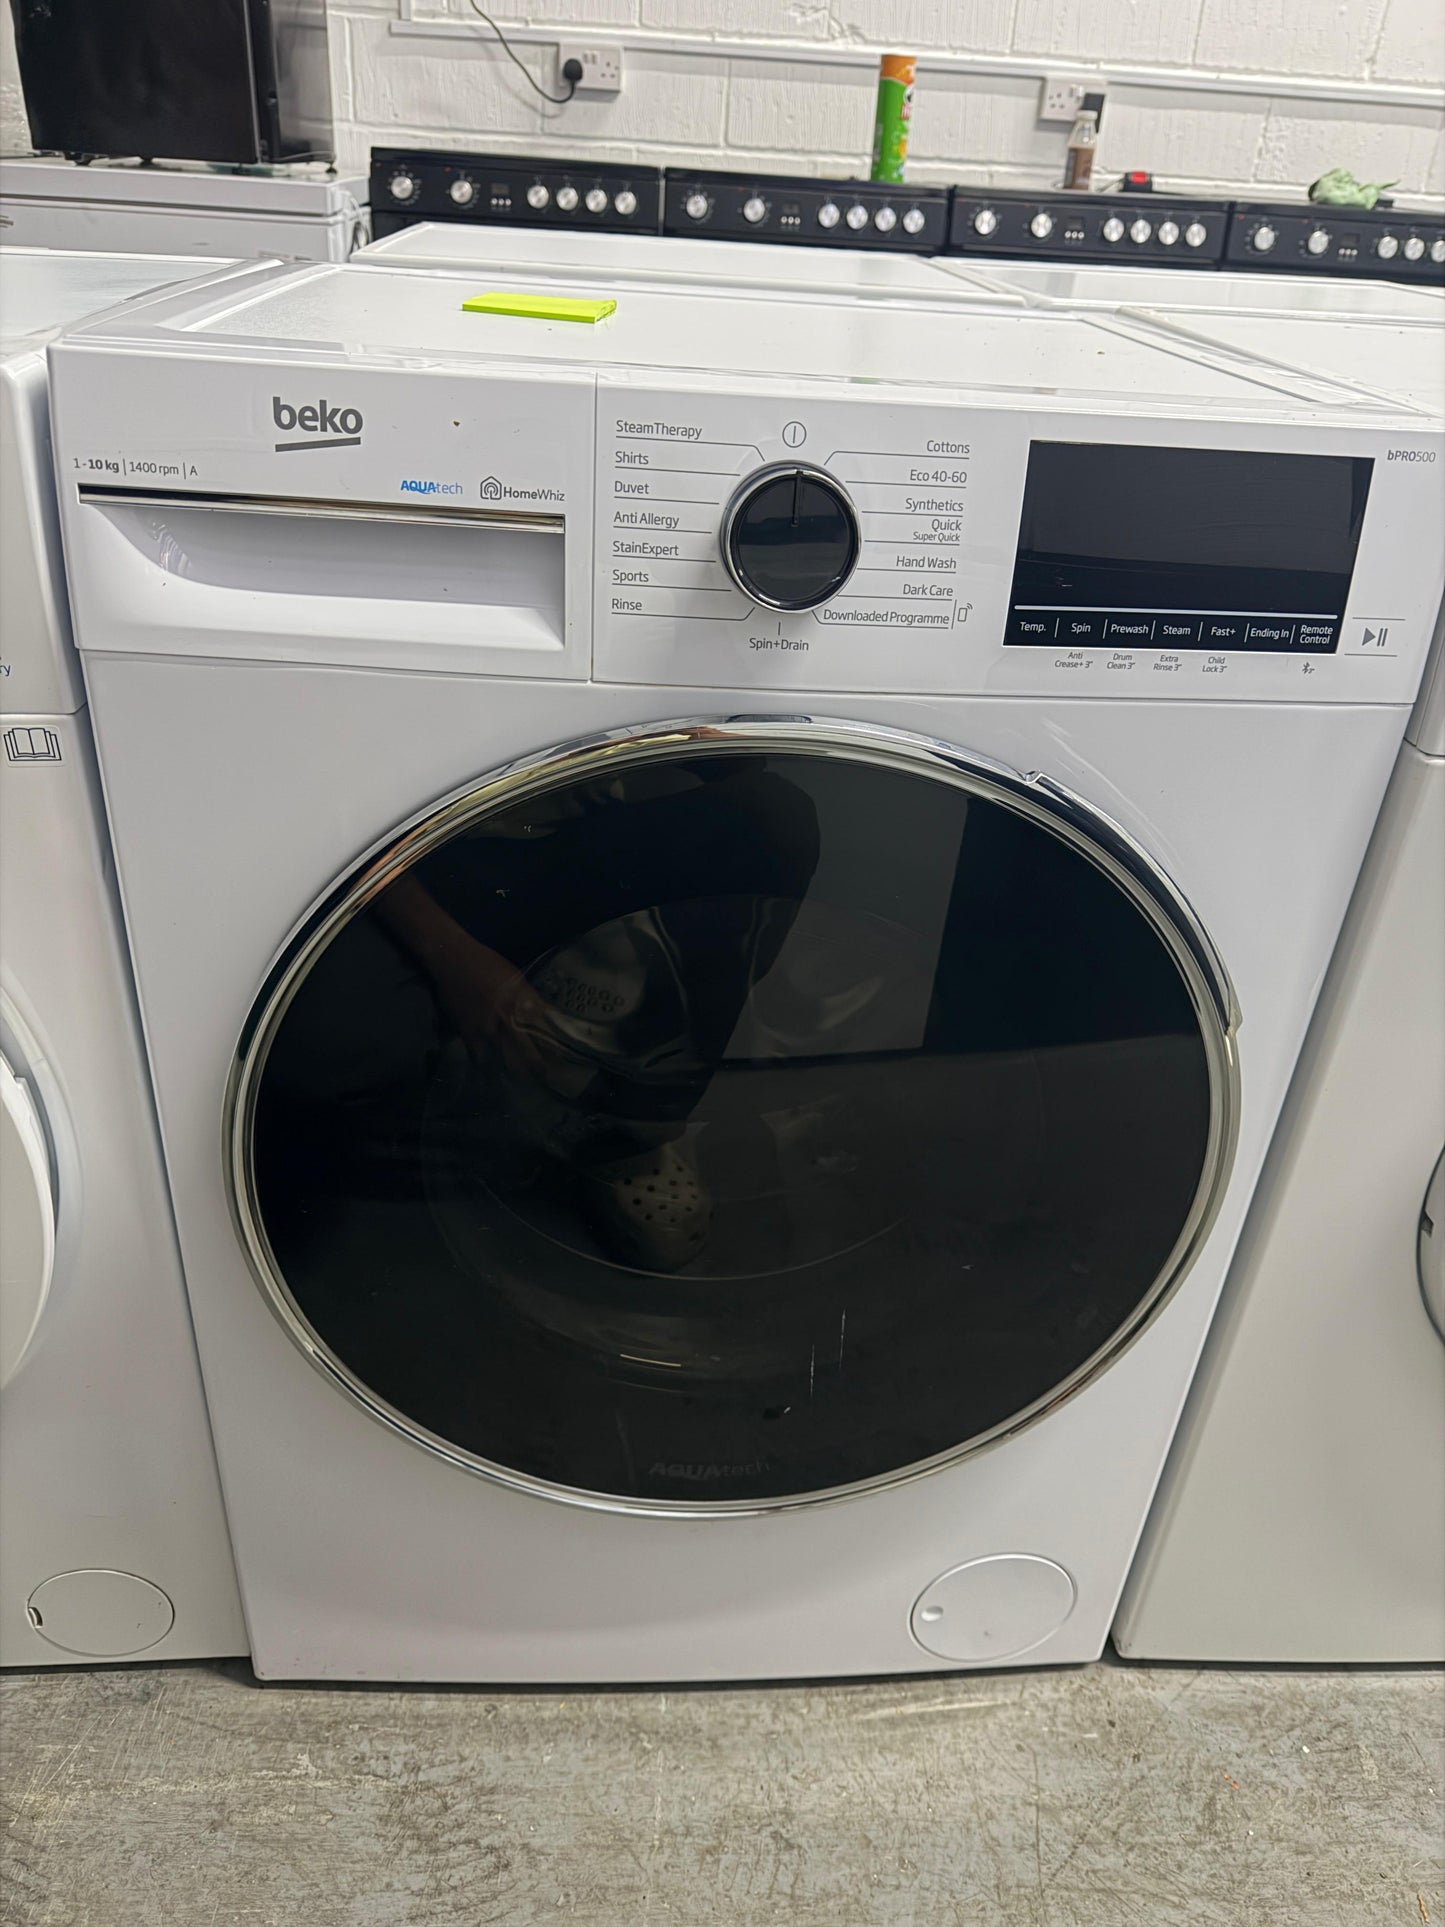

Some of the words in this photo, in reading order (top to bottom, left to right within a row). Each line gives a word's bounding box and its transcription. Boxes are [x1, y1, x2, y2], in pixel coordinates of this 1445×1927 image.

[272, 395, 364, 435] beko
[616, 420, 703, 440] SteamTherapy
[926, 440, 971, 454] Cottons
[615, 451, 650, 465] Shirts
[1386, 449, 1437, 463] bPRO500
[105, 459, 119, 474] kg
[129, 461, 157, 474] 1400
[159, 464, 180, 477] rpm
[190, 465, 199, 477] A
[910, 469, 930, 482] Eco
[931, 470, 968, 484] 40-60
[400, 479, 464, 495] AQUAtech
[614, 480, 650, 495] Duvet
[503, 486, 566, 502] HomeWhiz
[905, 498, 964, 513] Synthetics
[613, 510, 638, 525] Anti
[639, 512, 680, 529] Allergy
[931, 518, 962, 532] Quick
[913, 531, 937, 542] Super
[938, 532, 961, 543] Quick
[612, 540, 680, 558] StainExpert
[896, 555, 927, 569] Hand
[927, 557, 957, 570] Wash
[612, 569, 650, 583] Sports
[902, 584, 928, 597] Dark
[929, 585, 954, 597] Care
[611, 598, 643, 611] Rinse
[823, 609, 889, 624] Downloaded
[890, 611, 950, 626] Programme
[1019, 621, 1047, 633] Temp.
[1071, 622, 1092, 634] Spin
[1110, 623, 1149, 635] Prewash
[1162, 625, 1191, 635] Steam
[1210, 626, 1237, 637] Fast+
[1250, 627, 1277, 639] Ending
[1278, 628, 1290, 639] In
[1301, 624, 1334, 635] Remote
[749, 637, 810, 652] Spin+Drain
[1300, 633, 1331, 645] Control
[1067, 651, 1084, 660] Anti
[1113, 652, 1133, 661] Drum
[1159, 654, 1179, 663] Extra
[1207, 656, 1226, 665] Child
[1054, 659, 1084, 669] Crease+
[1106, 661, 1127, 670] Clean
[1153, 663, 1173, 672] Rinse
[1202, 665, 1218, 673] Lock
